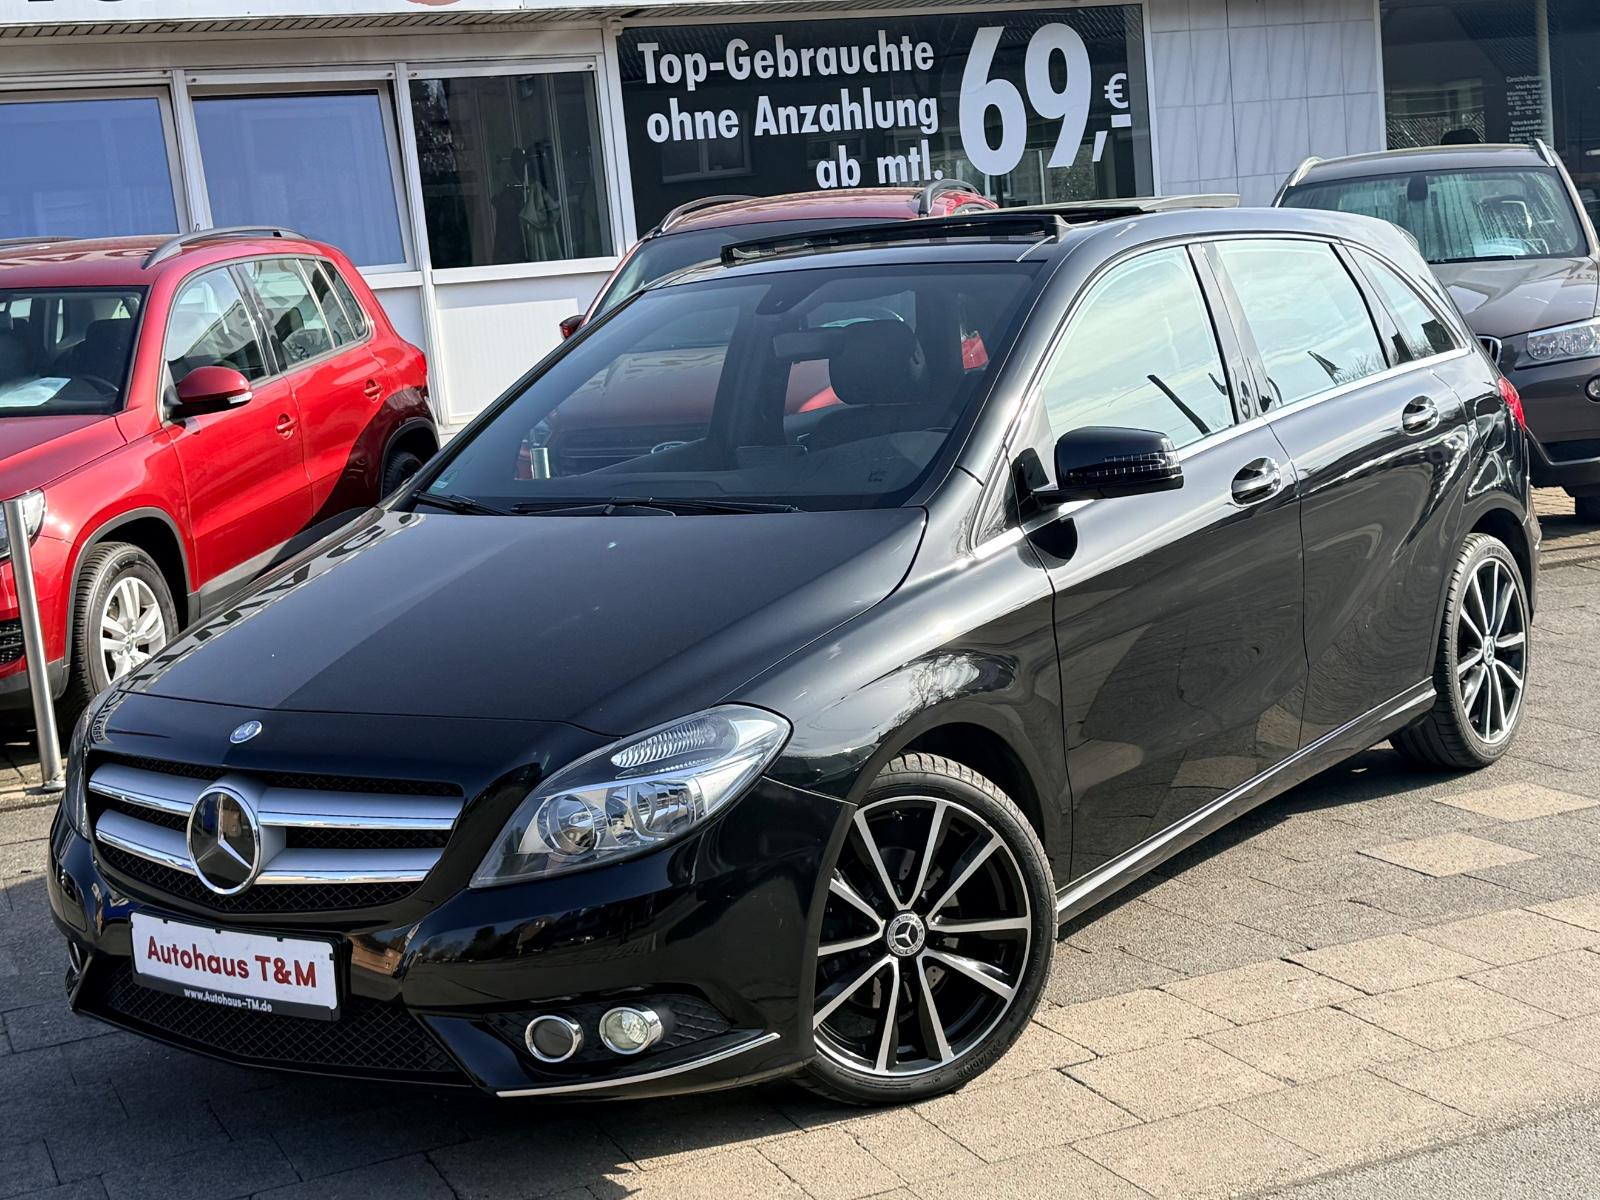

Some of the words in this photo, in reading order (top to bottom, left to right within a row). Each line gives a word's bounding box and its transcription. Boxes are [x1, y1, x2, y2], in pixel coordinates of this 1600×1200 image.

[637, 30, 934, 91] Top-Gebrauchte
[647, 97, 739, 143] ohne
[754, 88, 939, 136] Anzahlung
[1104, 72, 1129, 109] €
[816, 145, 861, 189] ab
[877, 139, 944, 184] mtl.
[147, 935, 250, 980] Autohaus
[254, 954, 317, 989] T&M
[184, 987, 273, 1013] www.Autohaus-TM.de
